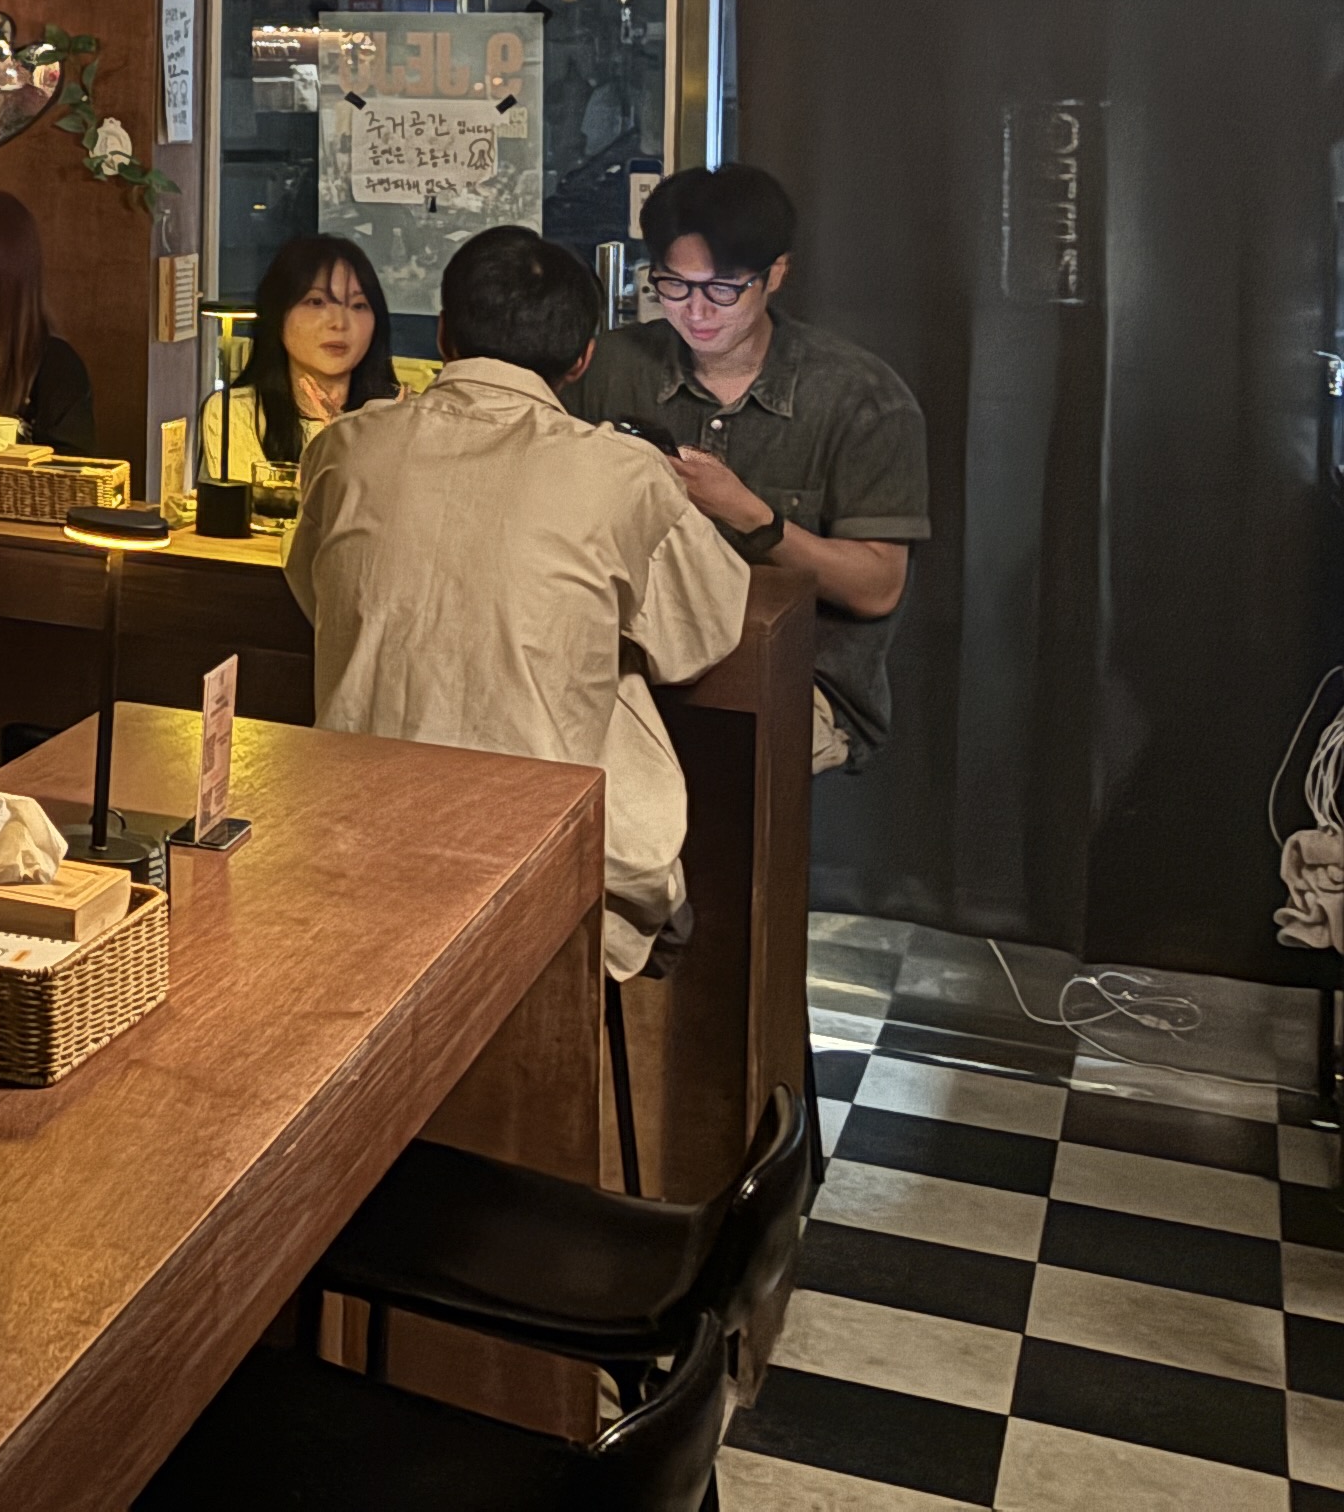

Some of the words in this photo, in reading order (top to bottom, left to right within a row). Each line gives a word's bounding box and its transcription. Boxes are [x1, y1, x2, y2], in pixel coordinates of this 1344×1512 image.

[365, 110, 451, 139] 주거공간
[457, 120, 494, 135] 입니다
[368, 142, 406, 166] 흡연은
